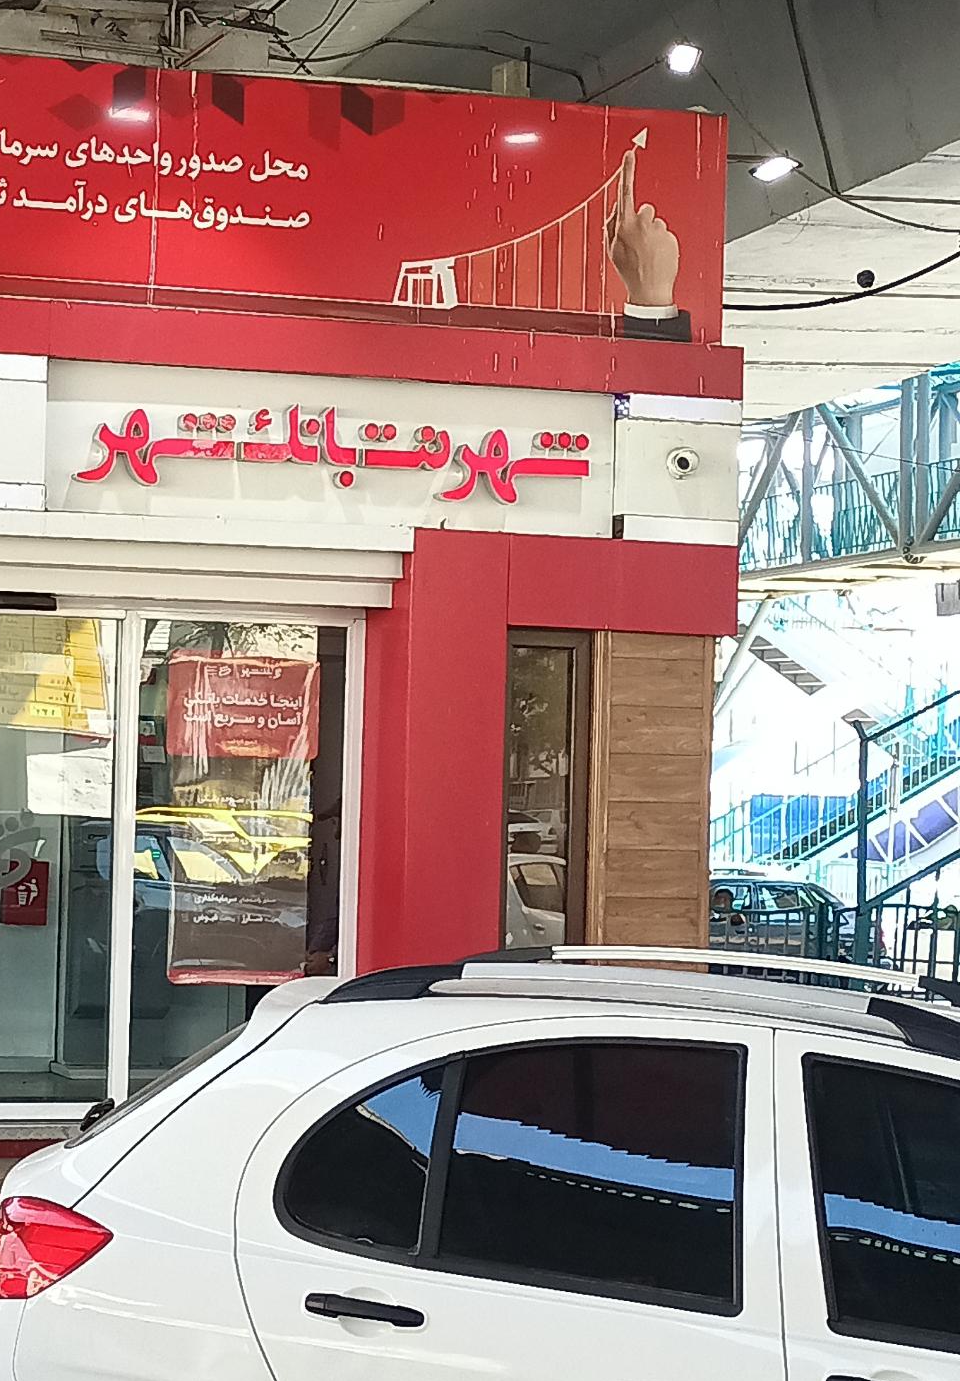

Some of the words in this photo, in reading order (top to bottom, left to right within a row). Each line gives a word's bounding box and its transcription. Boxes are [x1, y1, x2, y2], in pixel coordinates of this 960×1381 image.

[65, 135, 173, 175] واحدهای
[175, 152, 243, 180] صدور
[249, 150, 309, 182] محل
[13, 180, 108, 220] درآمد
[70, 407, 236, 486] شهر
[222, 694, 268, 707] خدمات
[270, 694, 303, 711] اینجا
[214, 715, 255, 728] سریع
[256, 716, 265, 728] و
[268, 712, 301, 729] آسان
